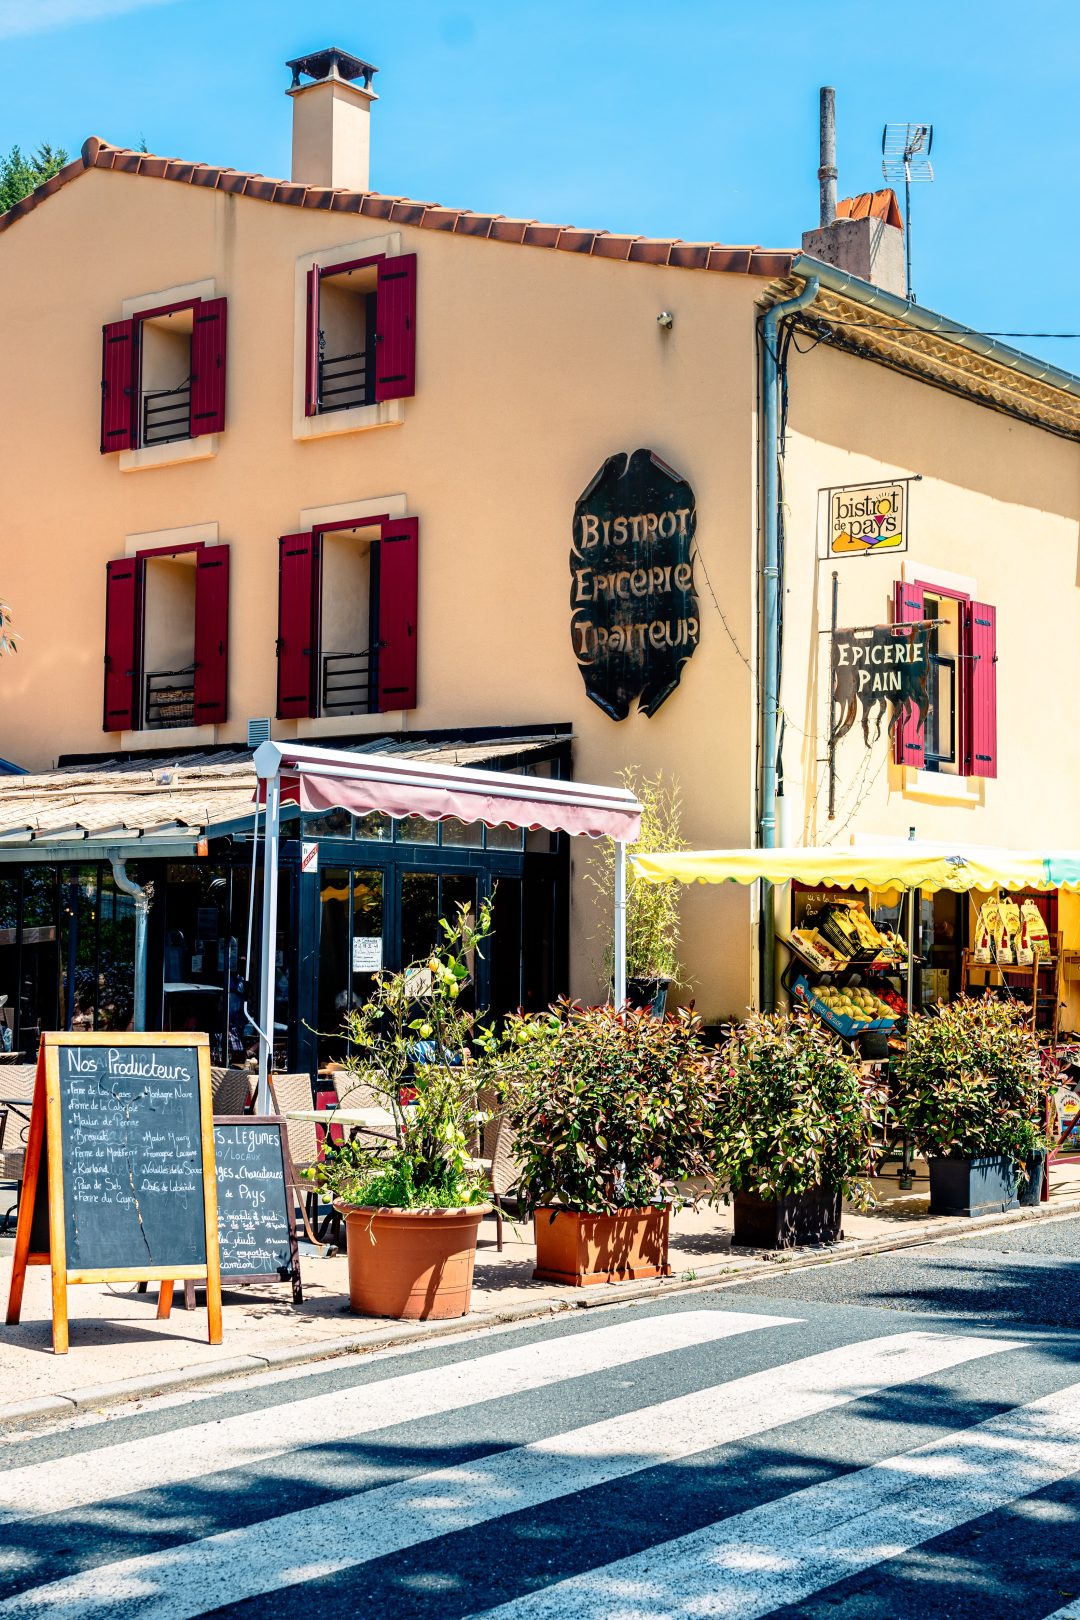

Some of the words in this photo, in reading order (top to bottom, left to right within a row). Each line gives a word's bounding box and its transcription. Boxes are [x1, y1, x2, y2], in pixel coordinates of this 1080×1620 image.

[835, 491, 899, 519] bistrot
[580, 508, 690, 549] BISTROT
[834, 520, 846, 531] de
[848, 516, 896, 543] pays
[837, 643, 923, 666] EPICERIE
[858, 669, 902, 693] PAIN
[68, 1047, 98, 1072] Nos
[108, 1048, 191, 1081] Producteurs
[88, 1085, 96, 1095] de
[91, 1098, 99, 1110] de
[103, 1115, 112, 1126] de
[96, 1147, 104, 1157] de
[94, 1180, 102, 1190] de
[102, 1192, 112, 1204] du
[225, 1189, 234, 1198] de
